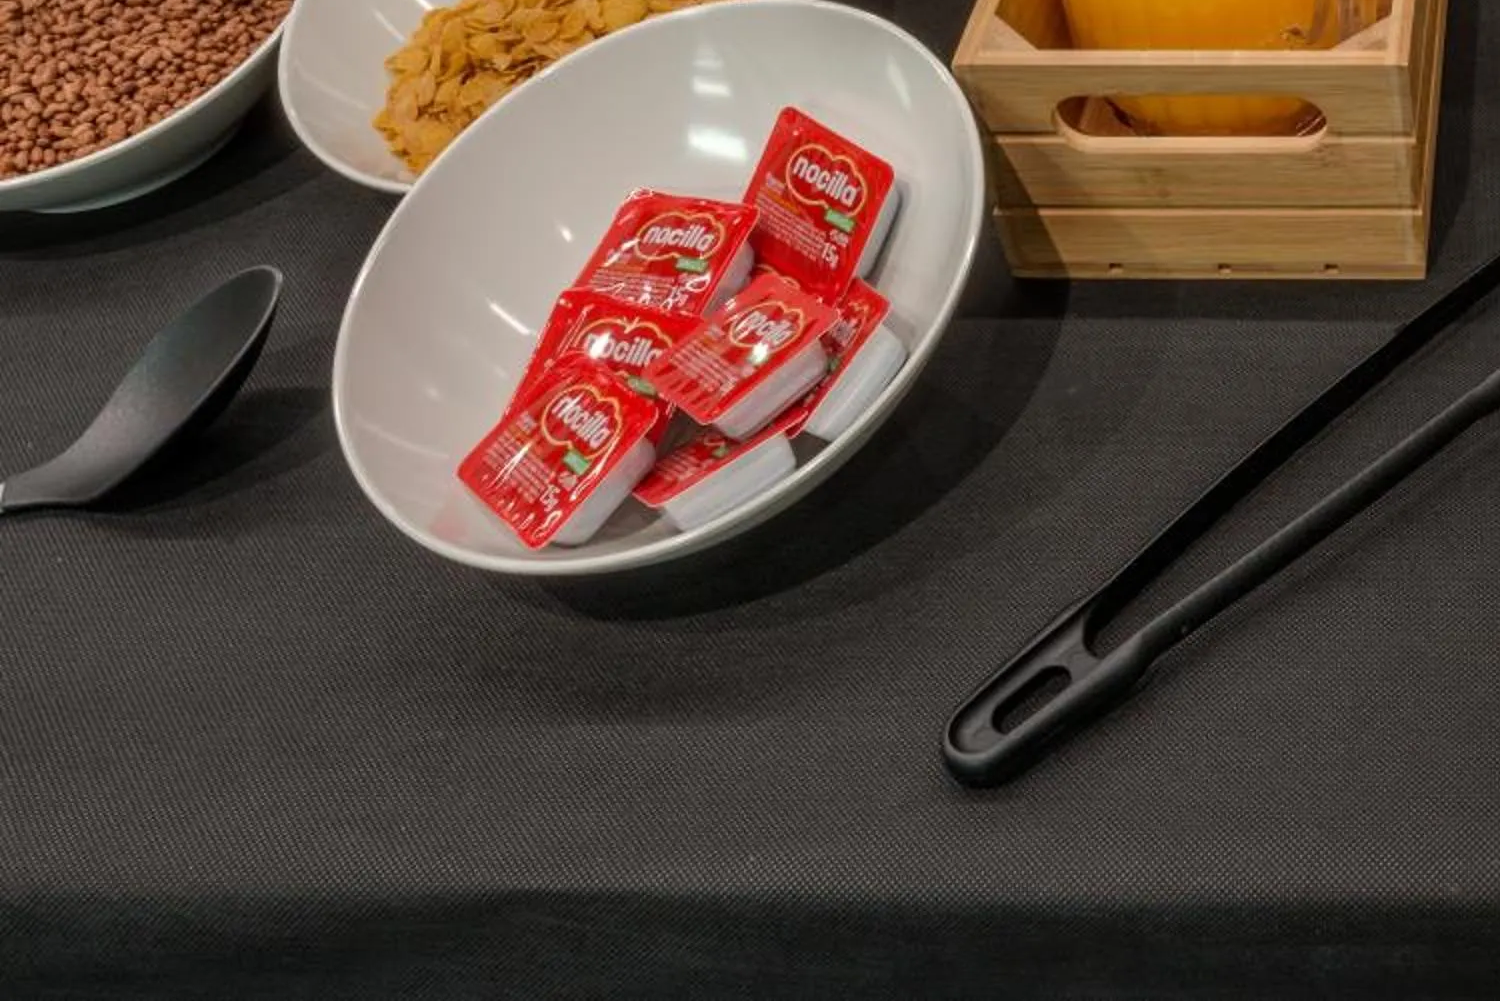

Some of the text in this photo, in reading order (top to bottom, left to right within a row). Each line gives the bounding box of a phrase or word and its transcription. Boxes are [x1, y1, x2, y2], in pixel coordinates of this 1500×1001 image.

[792, 155, 858, 207] nocilla
[641, 224, 716, 252] nocilla
[551, 393, 611, 449] nocilla
